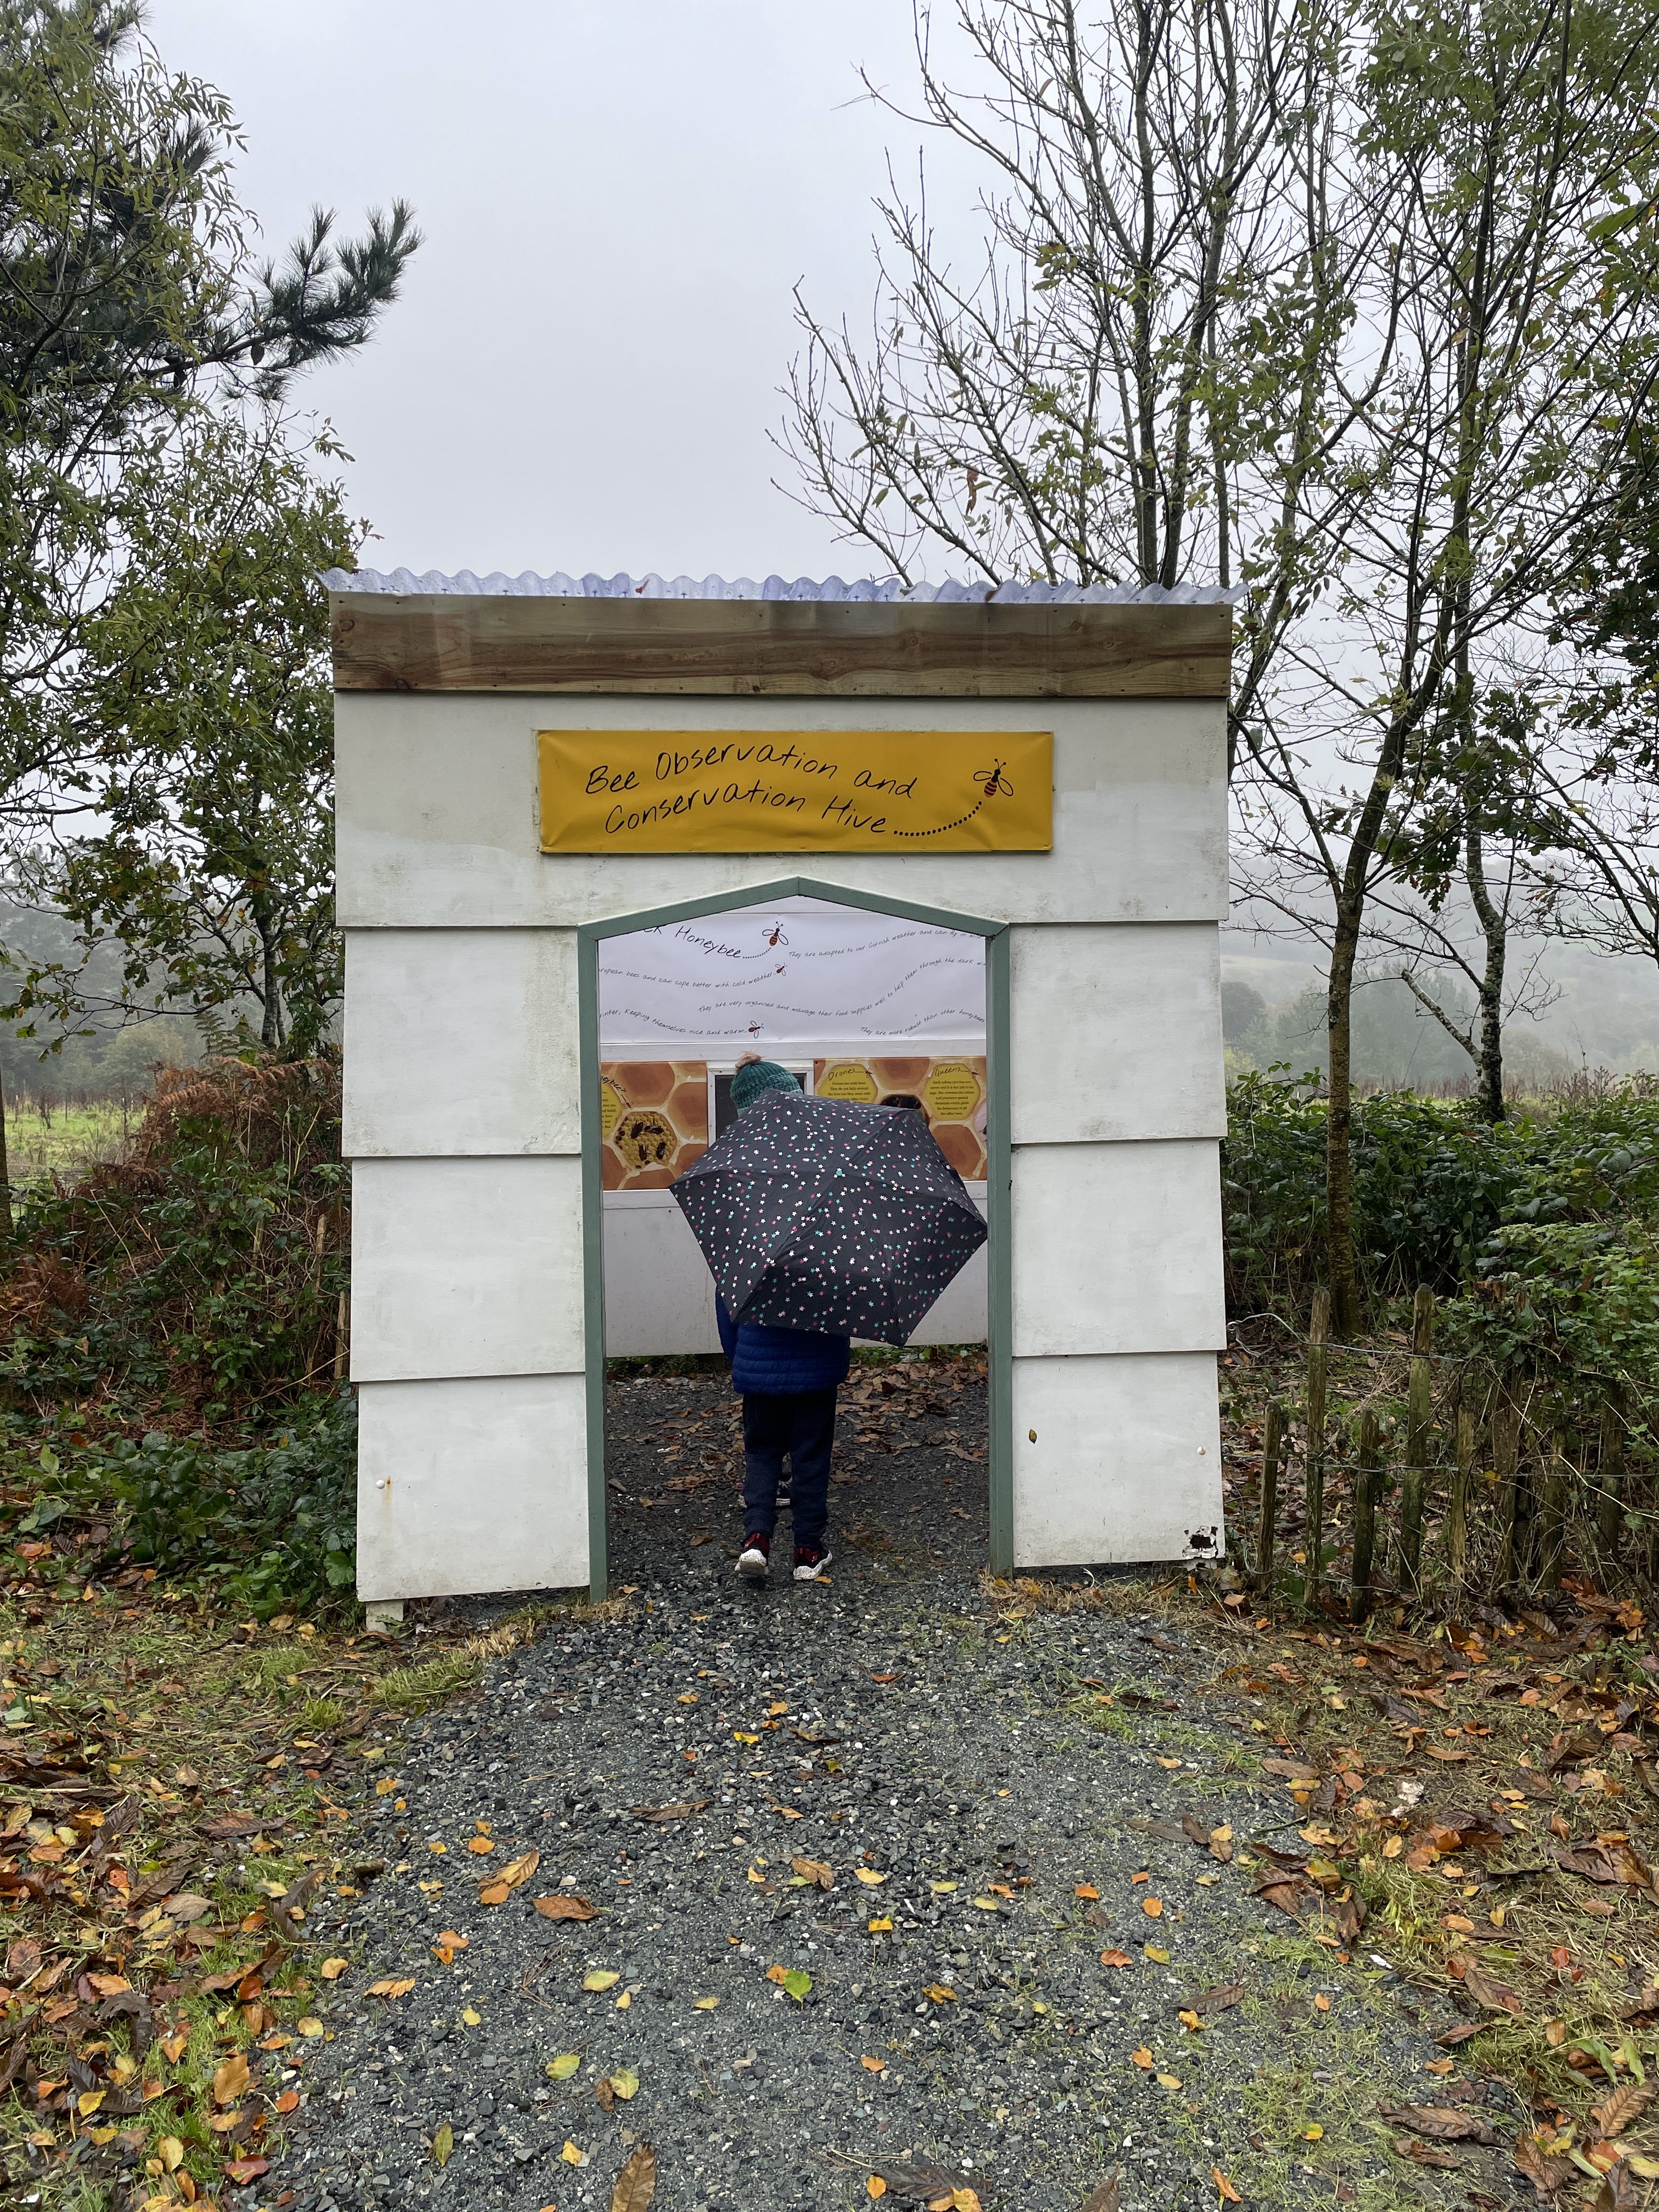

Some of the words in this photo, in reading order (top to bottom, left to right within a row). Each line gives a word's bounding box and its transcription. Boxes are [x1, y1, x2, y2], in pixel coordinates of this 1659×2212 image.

[585, 765, 640, 794] Bee
[655, 742, 837, 781] Observation
[854, 769, 918, 799] and
[605, 778, 806, 834] Conservation
[821, 794, 886, 833] Hive
[675, 926, 741, 958] Honeybee
[819, 949, 844, 957] adapted
[868, 937, 890, 949] Cornish
[892, 930, 917, 940] weather
[748, 972, 772, 984] weather
[851, 1004, 872, 1015] supplies
[875, 996, 886, 1006] well
[894, 980, 904, 992] help
[905, 969, 917, 981] them
[919, 957, 942, 969] through
[652, 1018, 686, 1032] themselves
[861, 1026, 873, 1035] They
[905, 1020, 921, 1032] robust
[924, 1013, 938, 1022] than
[958, 1009, 985, 1023] honeybees
[828, 1068, 855, 1081] Drones
[935, 1067, 961, 1076] Queens
